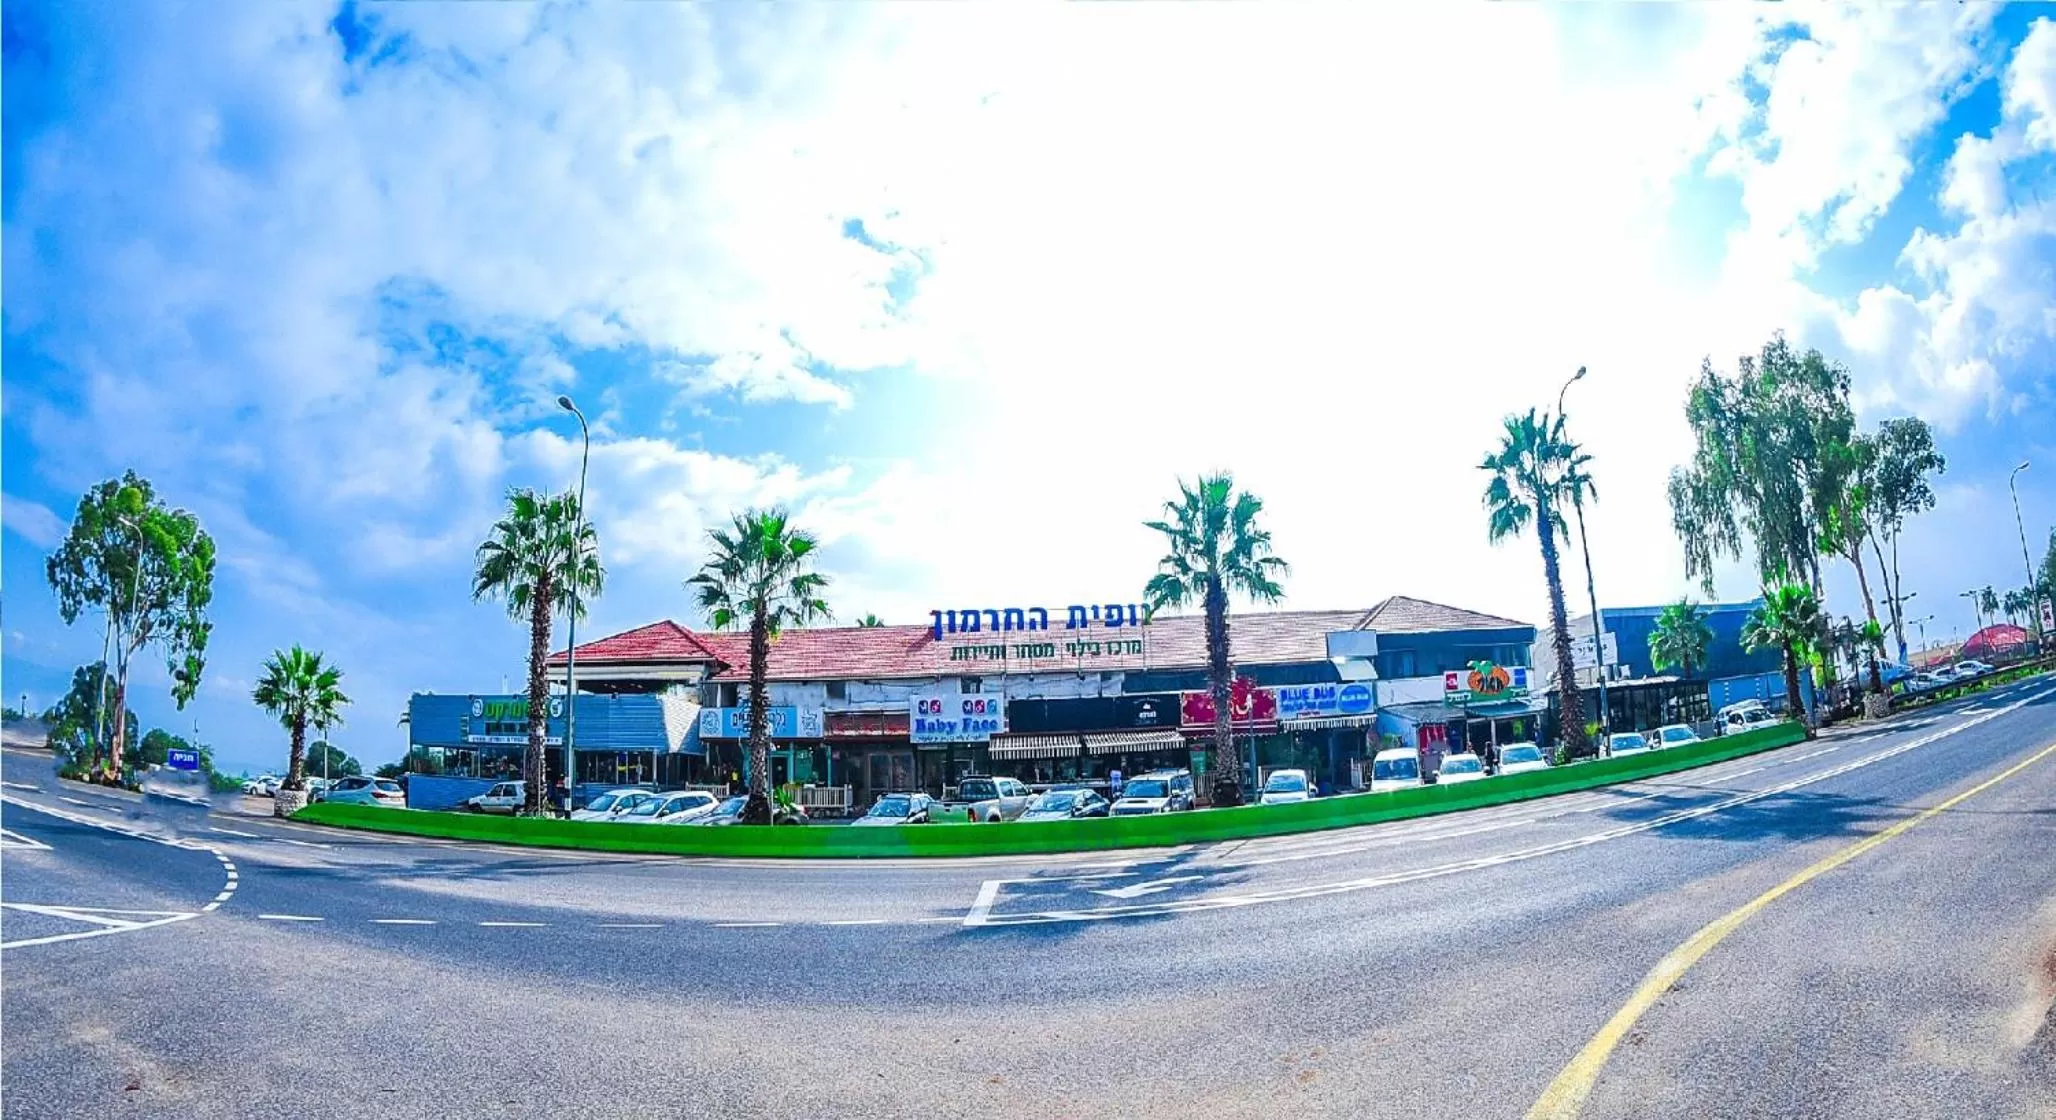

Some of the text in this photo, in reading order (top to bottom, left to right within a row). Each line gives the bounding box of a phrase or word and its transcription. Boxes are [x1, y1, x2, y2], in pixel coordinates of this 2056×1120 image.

[932, 607, 1048, 640] החרמון
[950, 638, 1142, 661] מרכז בילוי מסחר ותיירות
[1280, 686, 1335, 701] BLUE BUS
[915, 717, 998, 735] Baby Face
